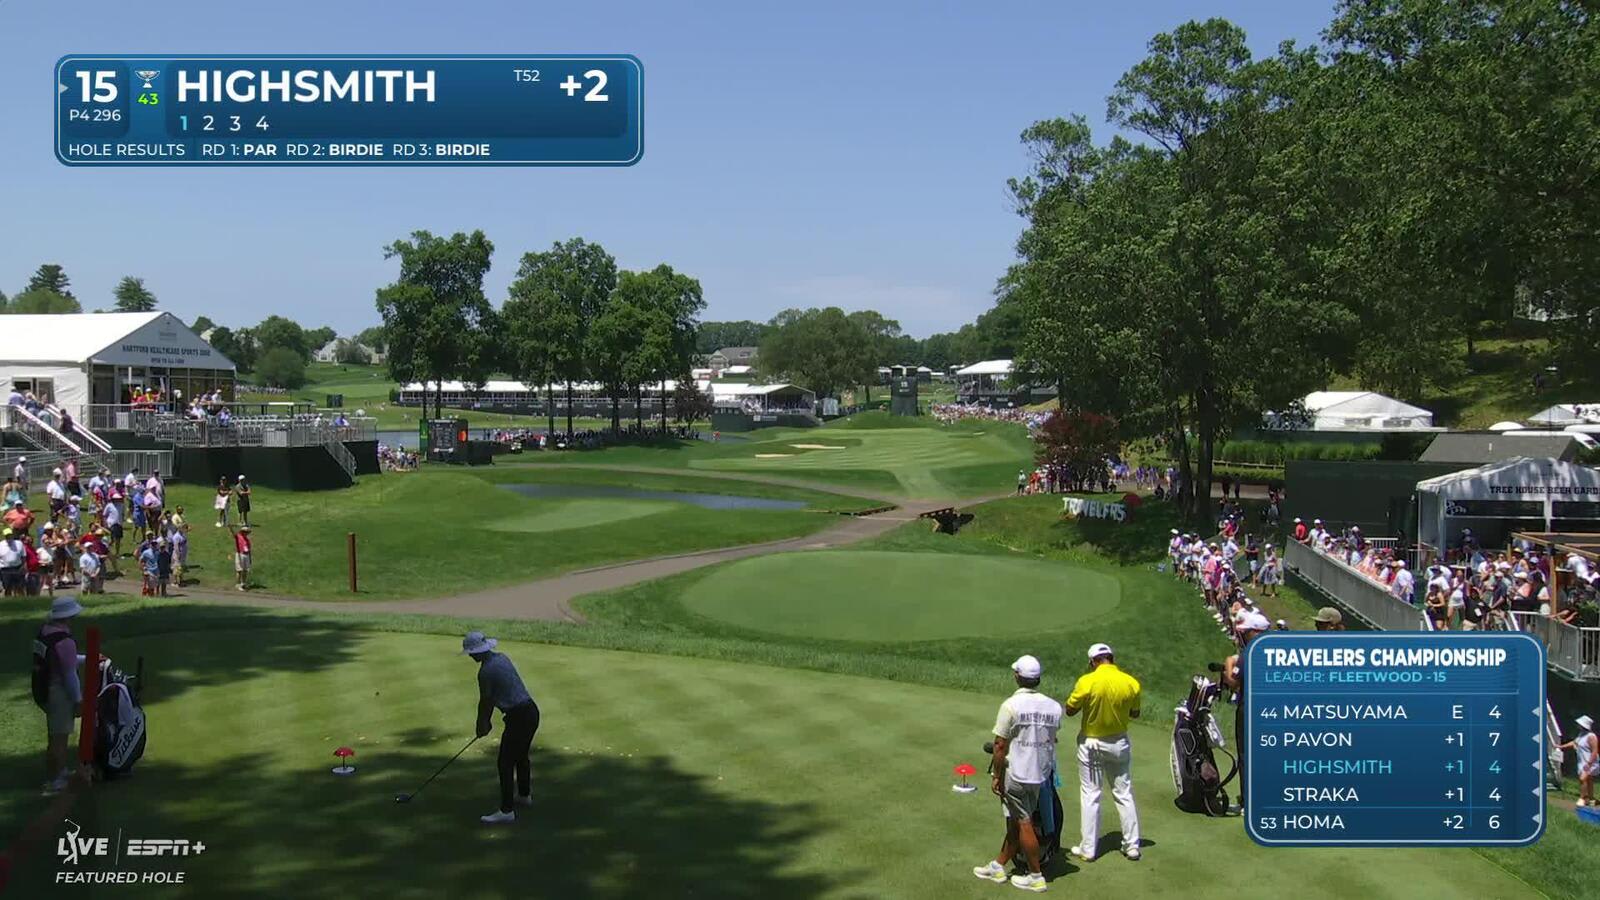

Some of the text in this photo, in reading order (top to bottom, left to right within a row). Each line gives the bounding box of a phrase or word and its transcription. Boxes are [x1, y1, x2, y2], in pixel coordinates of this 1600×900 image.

[1490, 485, 1600, 496] TREE HOUSE BEER GARD
[1062, 497, 1127, 520] TRAVELERS
[1020, 711, 1056, 723] MATSUYAMA
